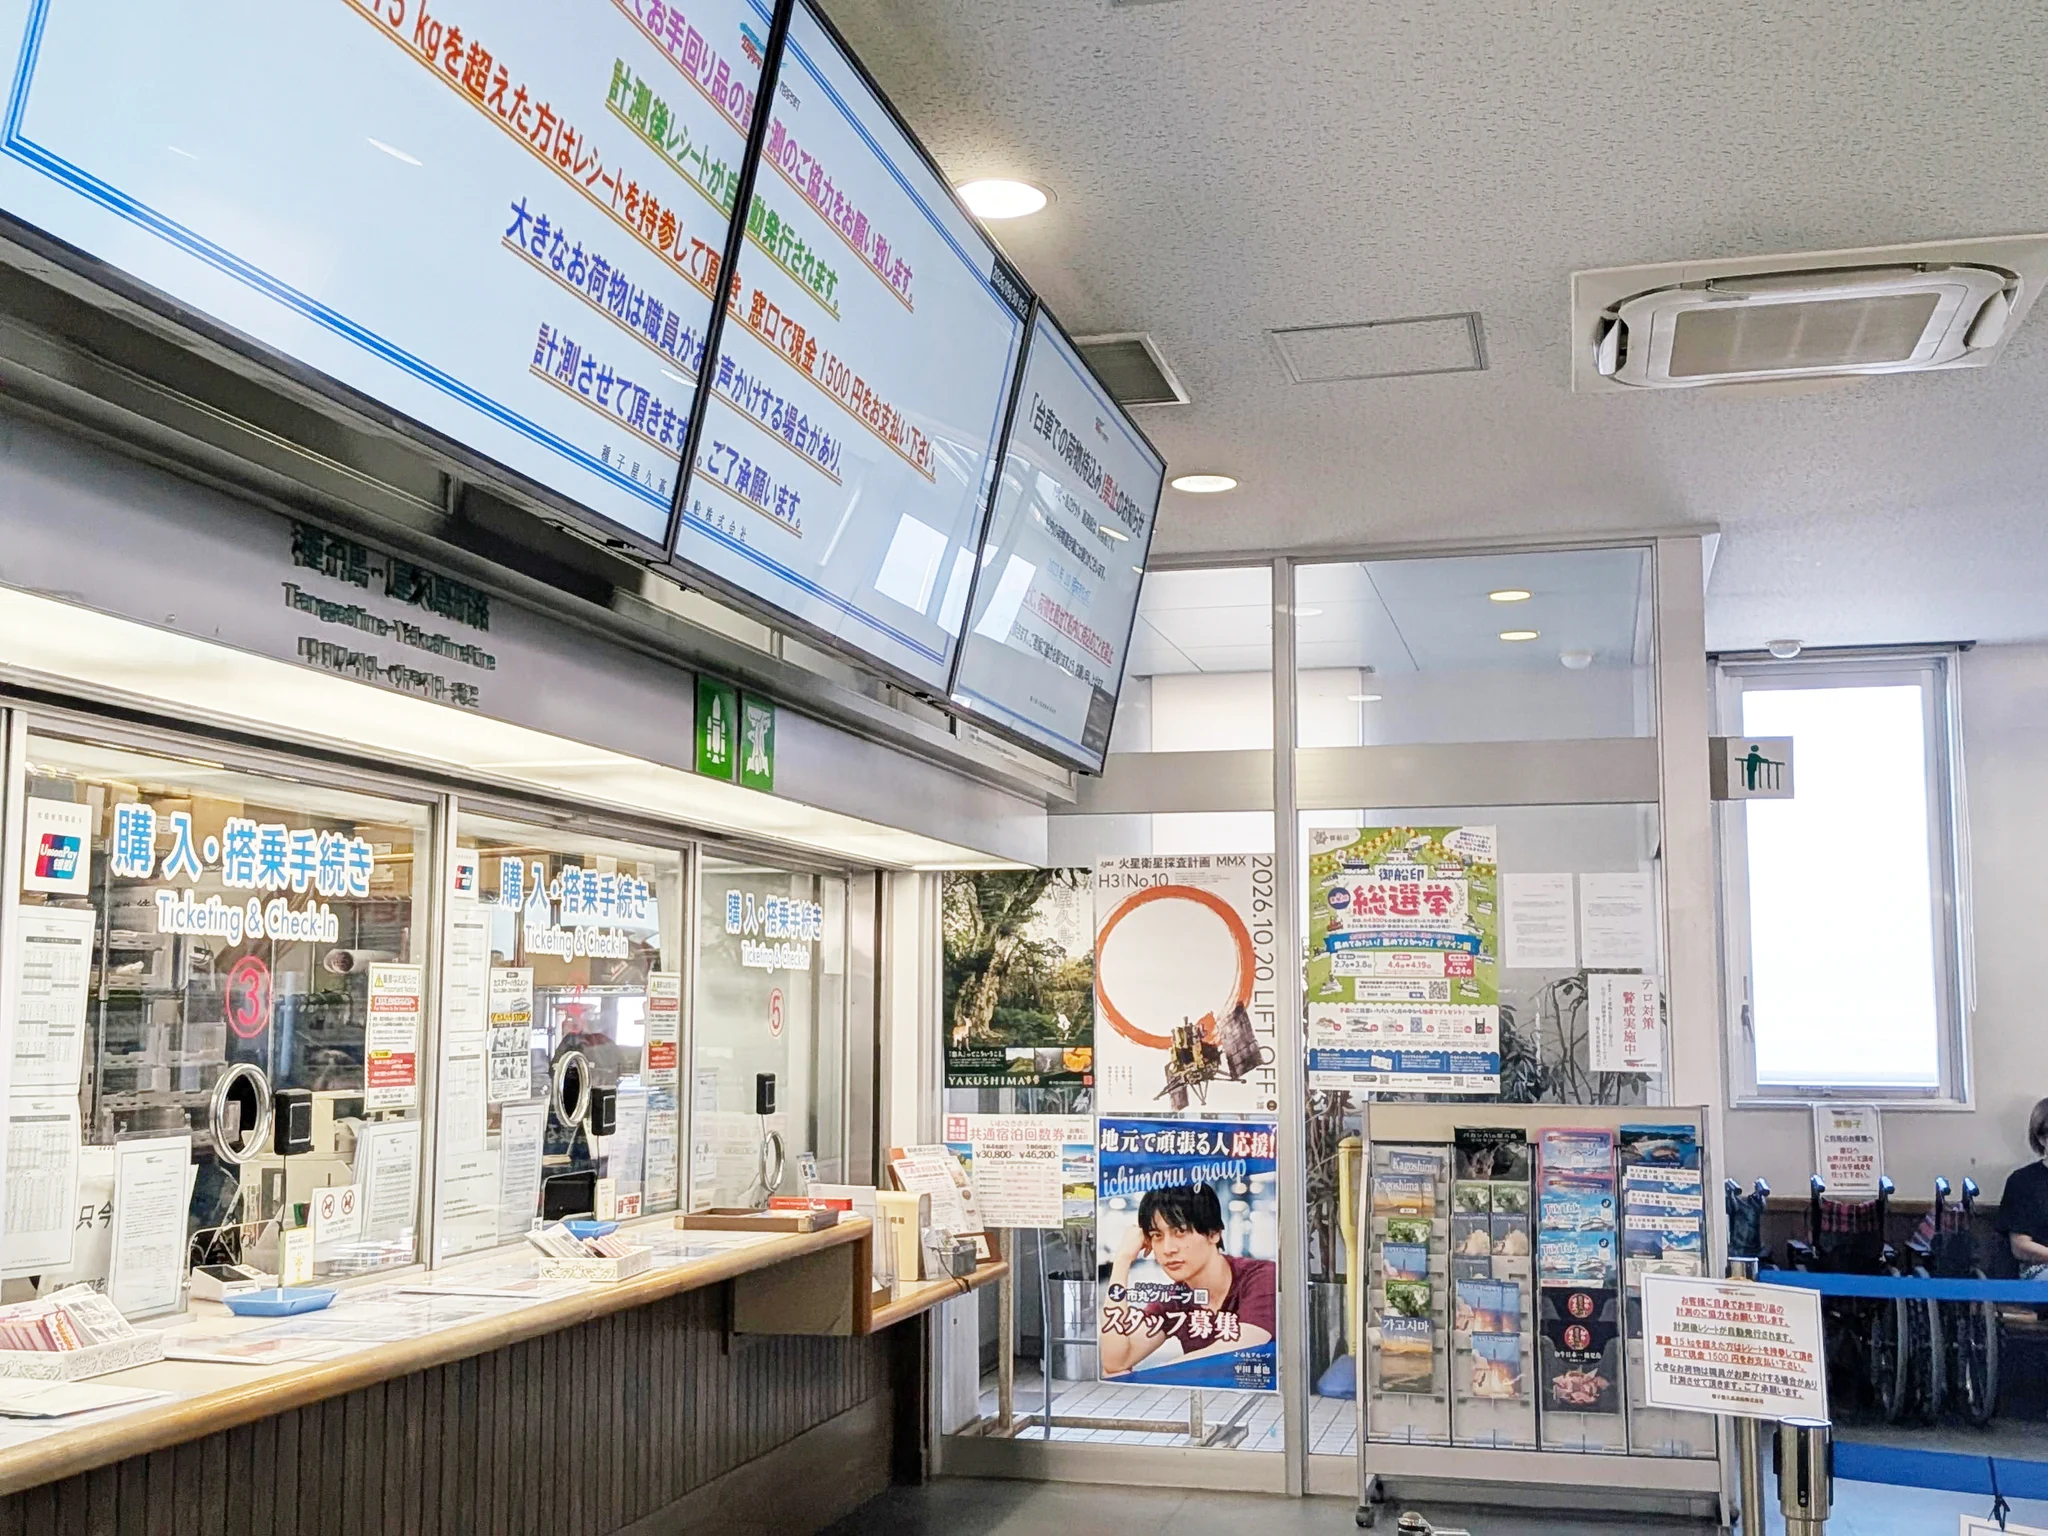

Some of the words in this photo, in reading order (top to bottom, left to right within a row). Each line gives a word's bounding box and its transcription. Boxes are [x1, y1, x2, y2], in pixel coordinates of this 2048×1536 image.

[39, 843, 78, 861] UnionPay
[1118, 856, 1211, 870] 火星衛星探査計画
[1216, 855, 1247, 867] MMX
[1378, 867, 1425, 882] 御船印
[157, 892, 243, 944] Ticketing
[246, 902, 263, 935] &
[267, 898, 339, 943] Check-In
[1251, 855, 1275, 982] 2026.10.20
[1351, 884, 1454, 918] 総選挙
[525, 923, 573, 963] Ticketing
[575, 926, 585, 952] &
[586, 927, 630, 960] Check-In
[1254, 990, 1276, 1038] LIFT
[1641, 978, 1656, 1031] テロ対策
[1622, 990, 1637, 1057] 警戒実施中
[948, 1075, 1026, 1087] YAKUSHIMA
[1256, 1046, 1277, 1095] OFF
[969, 1127, 1066, 1142] 共通宿泊回数券
[1103, 1164, 1187, 1198] ichimaru
[1190, 1158, 1247, 1194] group
[1125, 1288, 1193, 1304] 市丸グループ
[1102, 1306, 1241, 1341] スタッフ募集
[1383, 1318, 1430, 1334] 가고시마
